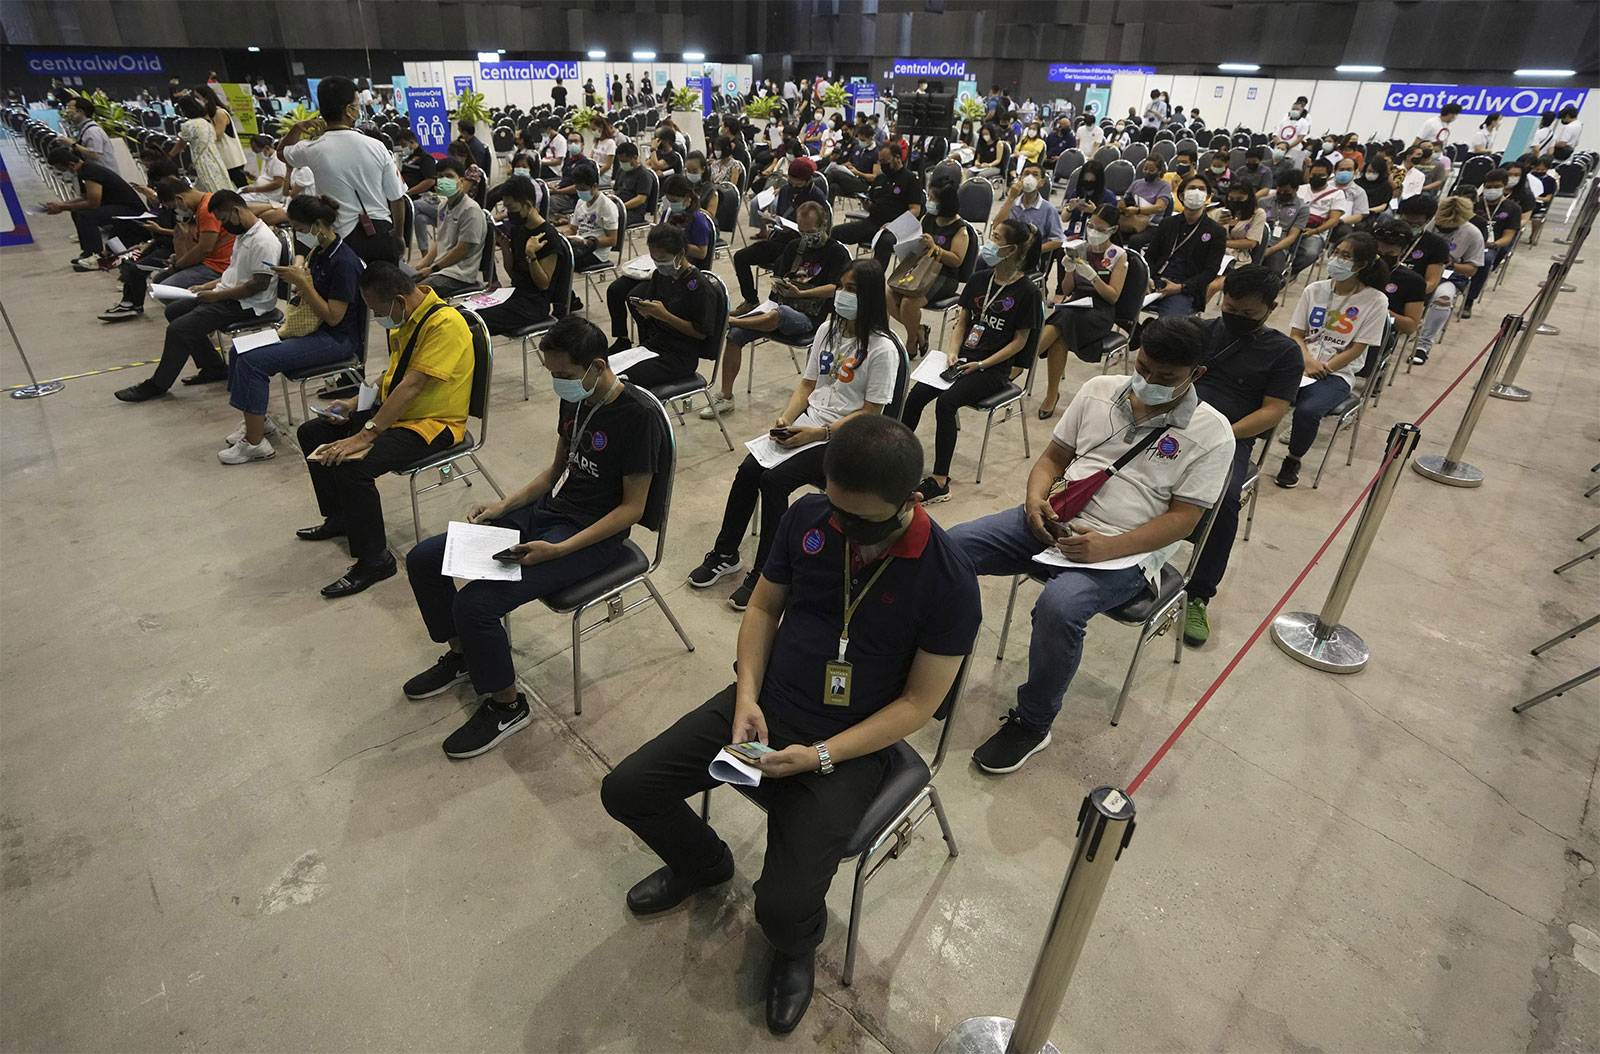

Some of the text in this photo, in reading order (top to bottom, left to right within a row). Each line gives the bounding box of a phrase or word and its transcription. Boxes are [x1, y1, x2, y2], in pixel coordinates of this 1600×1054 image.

[30, 54, 162, 71] centralwOrld
[894, 61, 965, 75] centralwOrld
[481, 63, 577, 79] centralwOrld
[414, 97, 440, 108] ห้องน้ำ
[1387, 89, 1585, 114] centralwOrld
[1324, 335, 1346, 346] SPACE
